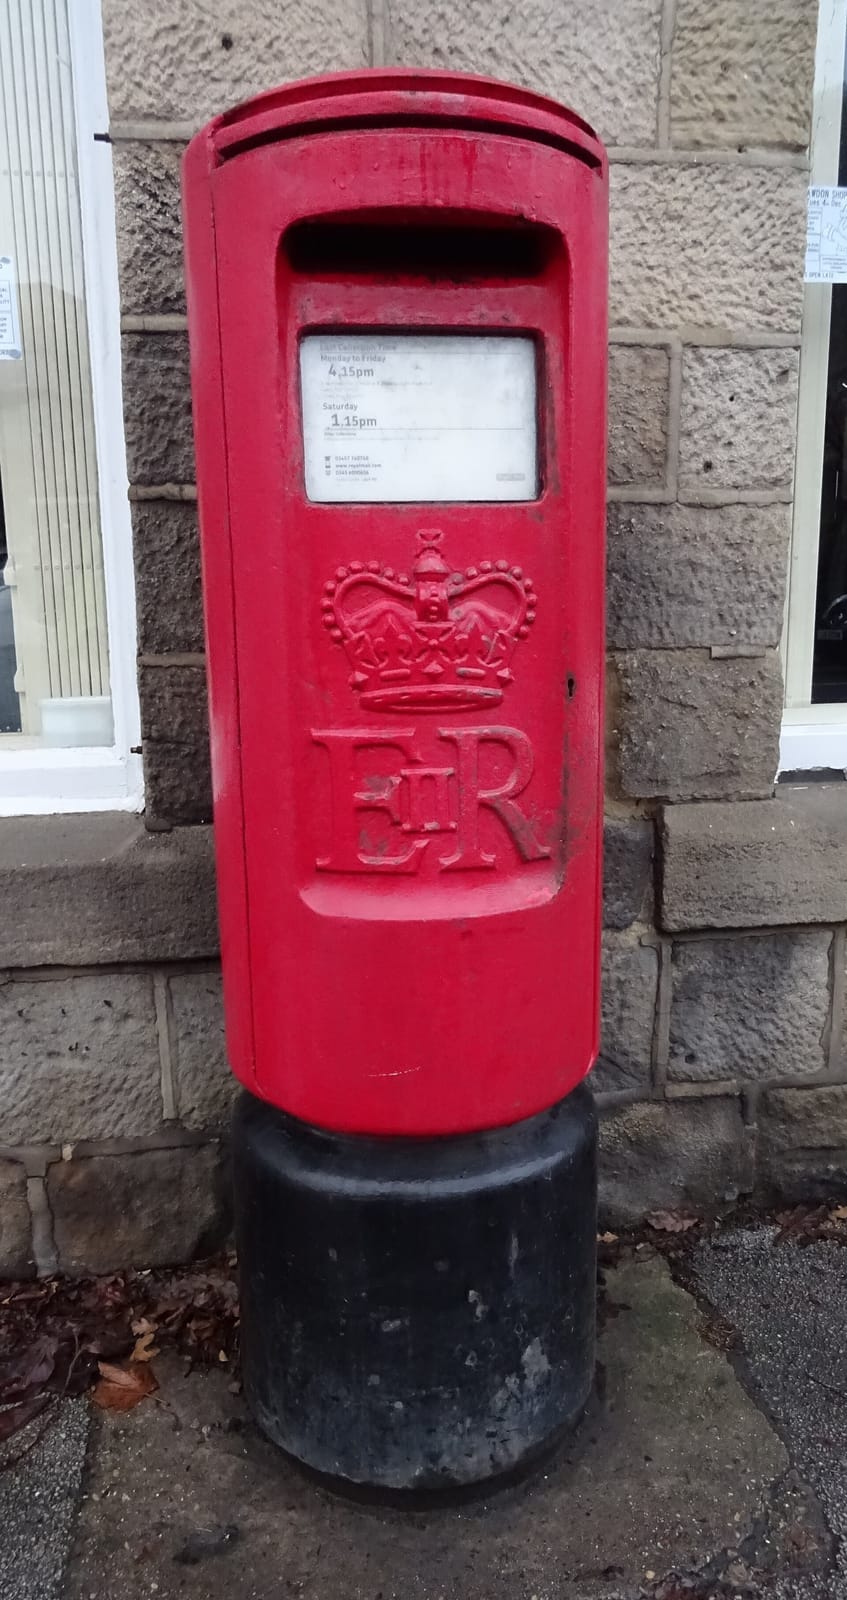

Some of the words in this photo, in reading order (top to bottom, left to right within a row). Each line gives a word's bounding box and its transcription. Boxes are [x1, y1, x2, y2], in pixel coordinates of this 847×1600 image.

[320, 354, 351, 363] Monday
[352, 354, 360, 362] to
[361, 354, 387, 363] Friday
[328, 363, 375, 379] 4.15pm
[322, 402, 359, 412] Saturday
[331, 413, 377, 429] 1.15pm
